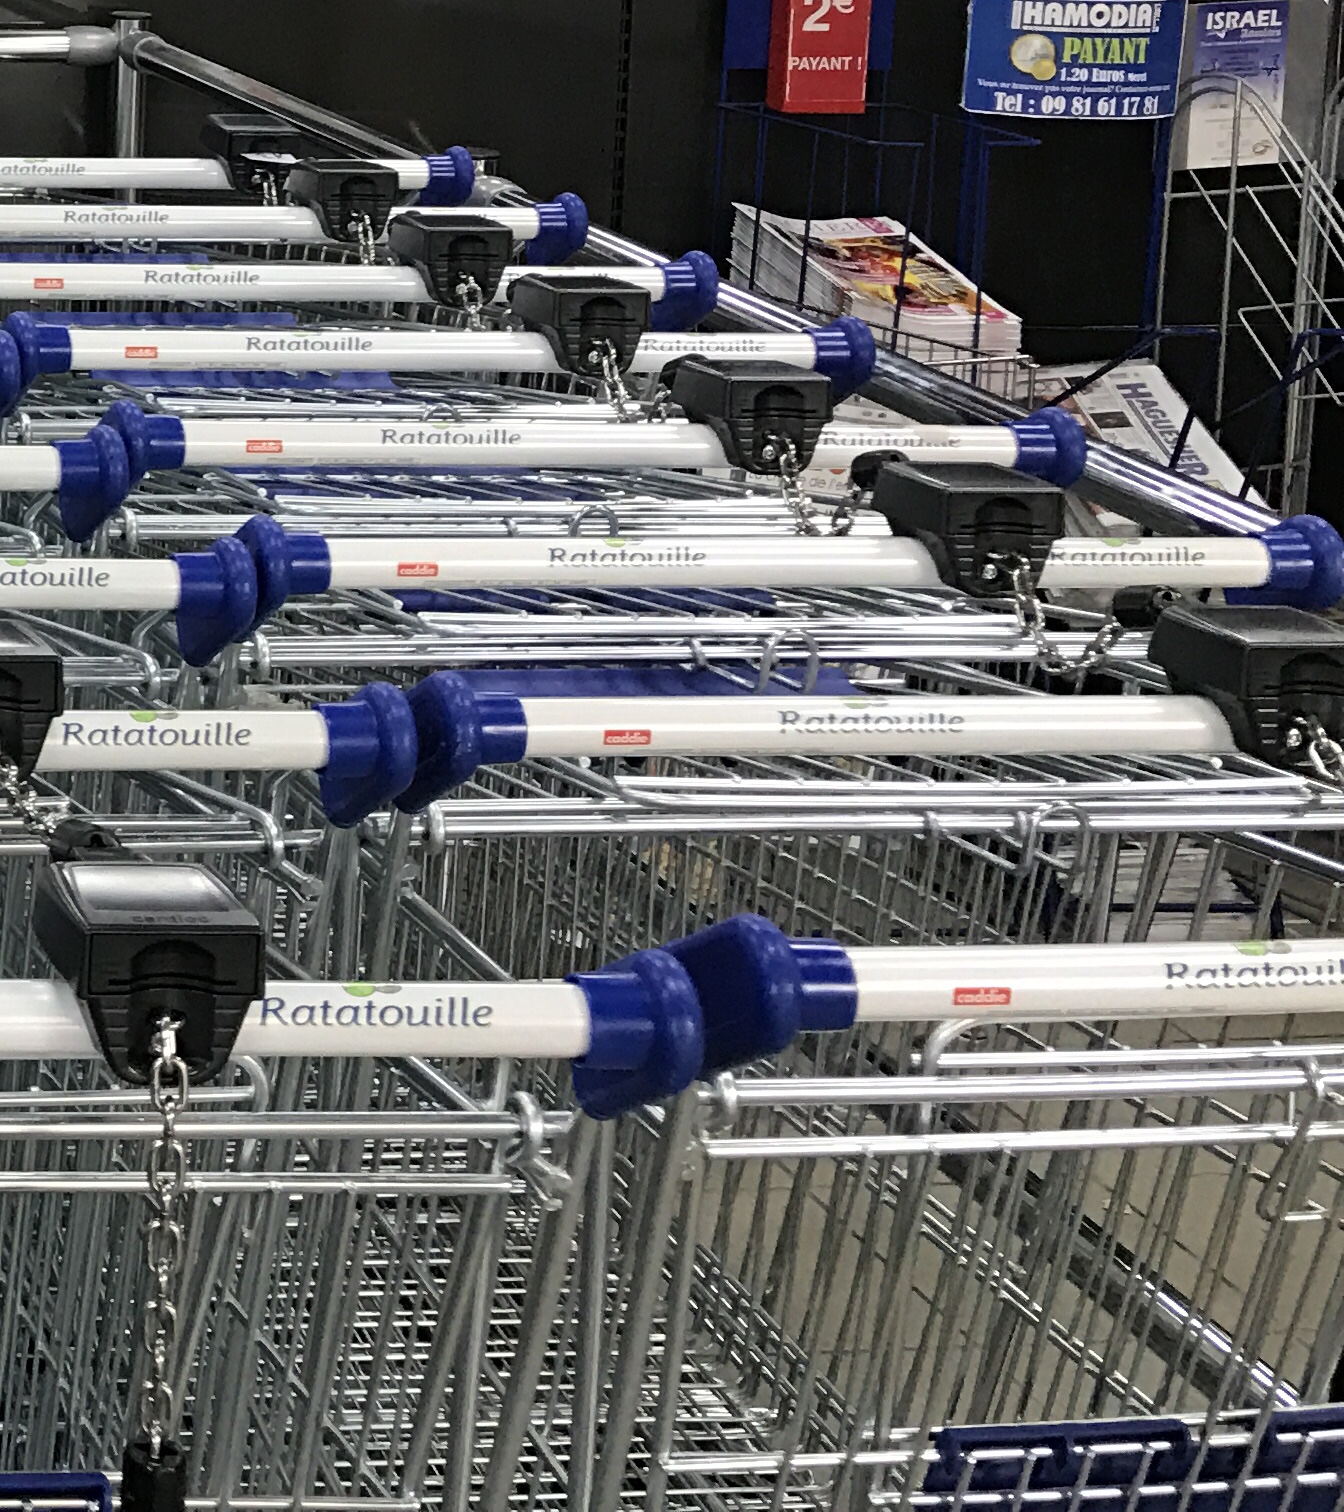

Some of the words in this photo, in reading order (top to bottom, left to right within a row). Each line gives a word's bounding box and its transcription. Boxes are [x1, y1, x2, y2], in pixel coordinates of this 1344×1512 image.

[1022, 0, 1152, 26] HAMODIA
[1206, 9, 1282, 31] ISRAEL
[1062, 37, 1151, 65] PAYANT
[789, 57, 853, 71] PAYANT
[1060, 68, 1088, 82] 1.20
[1092, 68, 1125, 83] Euros
[994, 92, 1023, 113] Tel
[1041, 96, 1066, 115] 09
[1071, 96, 1093, 116] 81
[1097, 96, 1118, 115] 61
[1122, 96, 1140, 115] 17
[1143, 96, 1159, 115] 81
[144, 268, 260, 287] Ratatouille
[246, 335, 374, 353] Ratatouille
[381, 428, 523, 447] Ratatouille
[61, 719, 252, 749] Ratatouille
[956, 990, 1008, 1005] caddie
[259, 994, 493, 1031] Ratatouille
